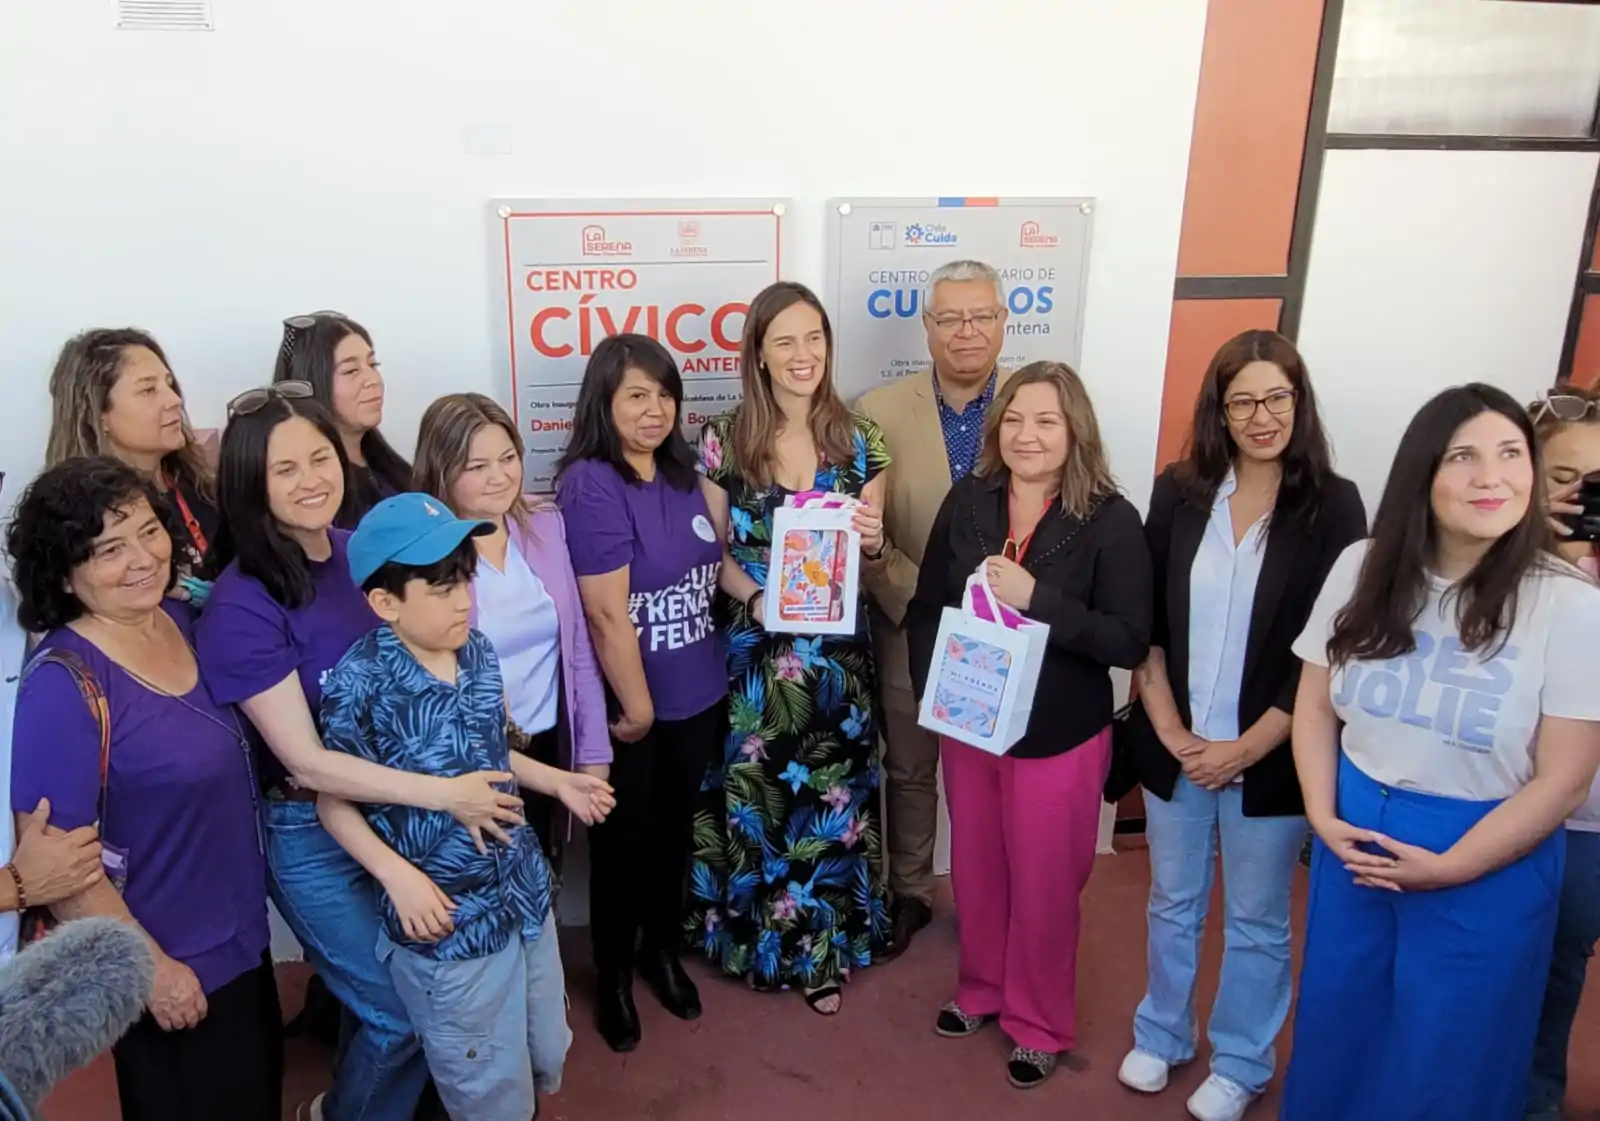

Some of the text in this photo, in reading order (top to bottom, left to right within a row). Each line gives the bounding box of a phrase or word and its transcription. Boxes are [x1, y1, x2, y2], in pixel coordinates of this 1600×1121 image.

[586, 232, 602, 242] LA
[924, 231, 958, 243] Cuida
[586, 241, 632, 252] SERENA
[526, 268, 637, 292] CENTRO
[868, 270, 930, 285] CENTRO
[1037, 268, 1056, 281] DE
[529, 293, 751, 358] CÍVICO
[1006, 322, 1051, 336] ntena
[531, 417, 574, 432] Danie
[1333, 662, 1503, 749] JOLIE
